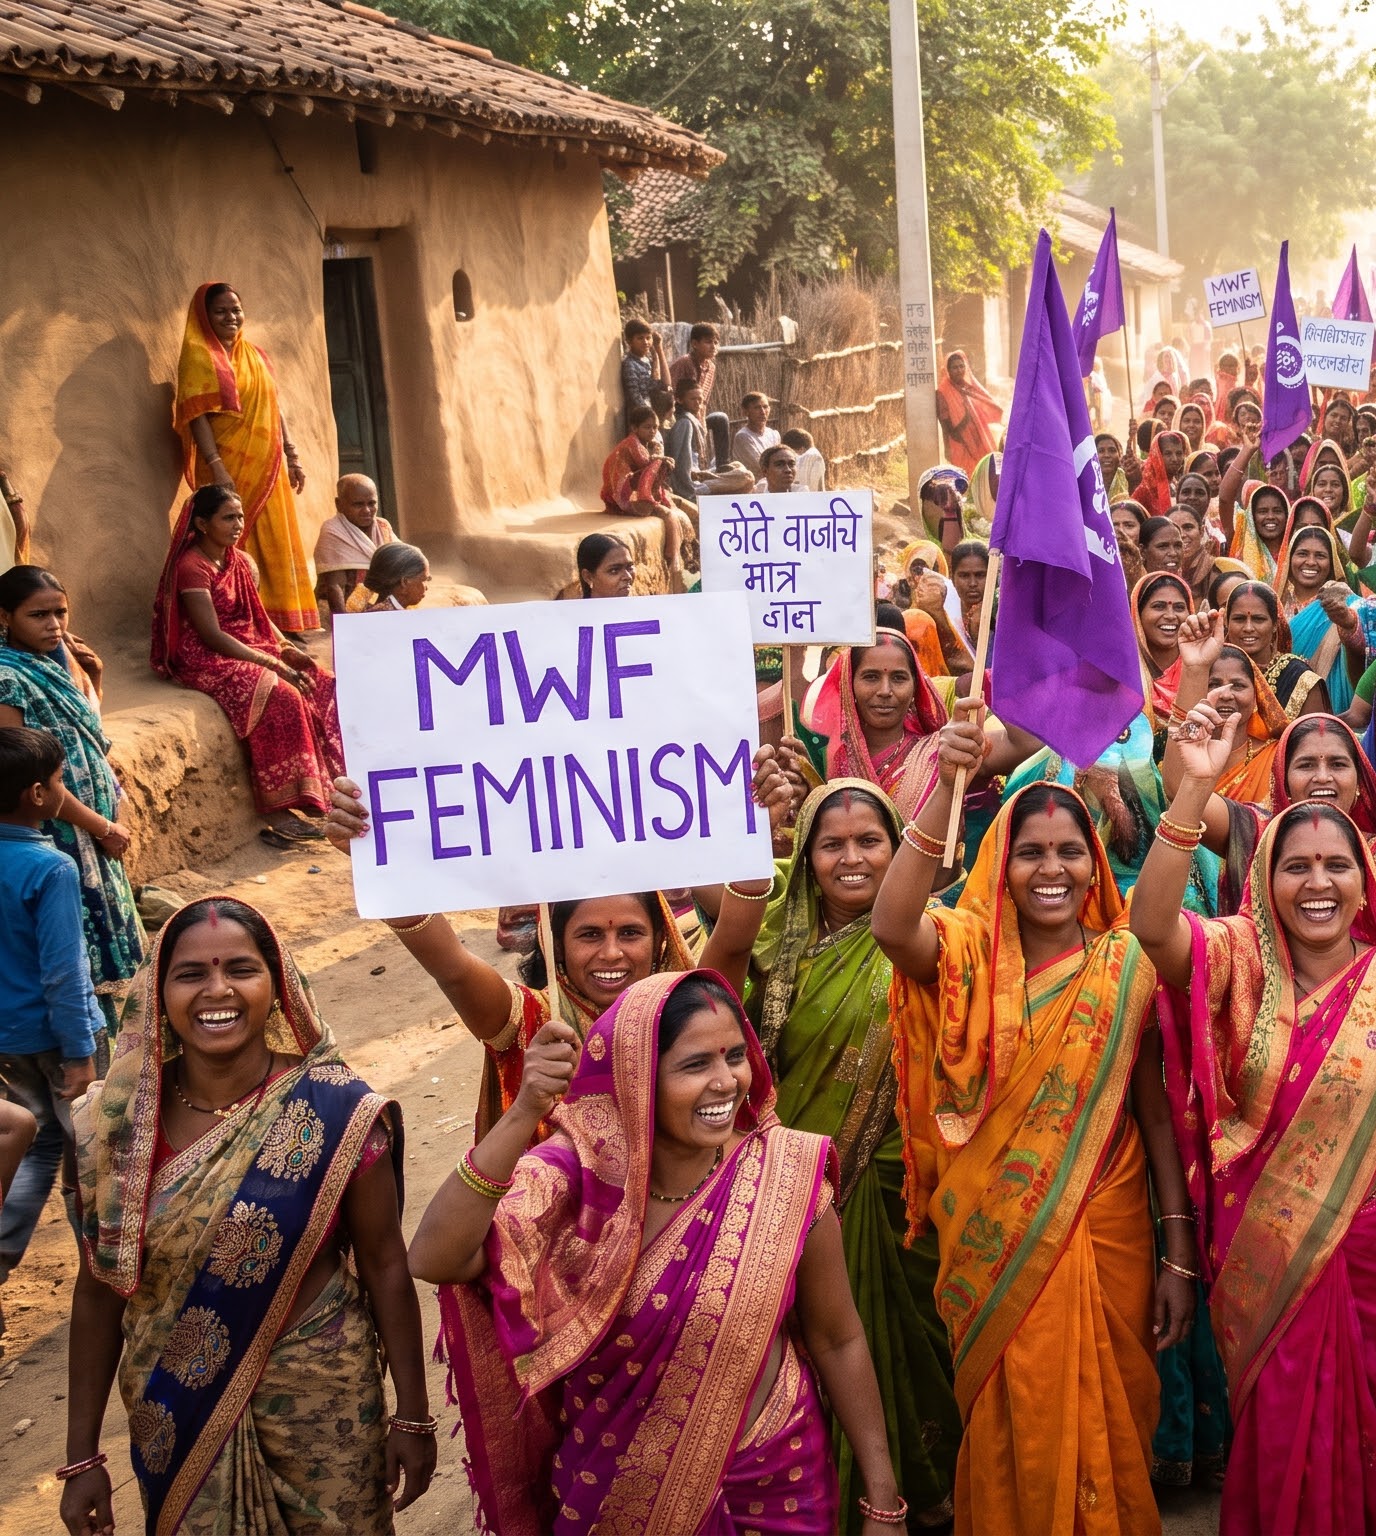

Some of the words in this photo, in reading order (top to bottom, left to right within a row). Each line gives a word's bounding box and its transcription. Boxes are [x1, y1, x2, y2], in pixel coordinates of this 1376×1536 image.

[1210, 271, 1251, 297] MWF
[742, 561, 801, 593] मात्र
[412, 619, 661, 731] MWF
[367, 738, 758, 866] FEMINISM
